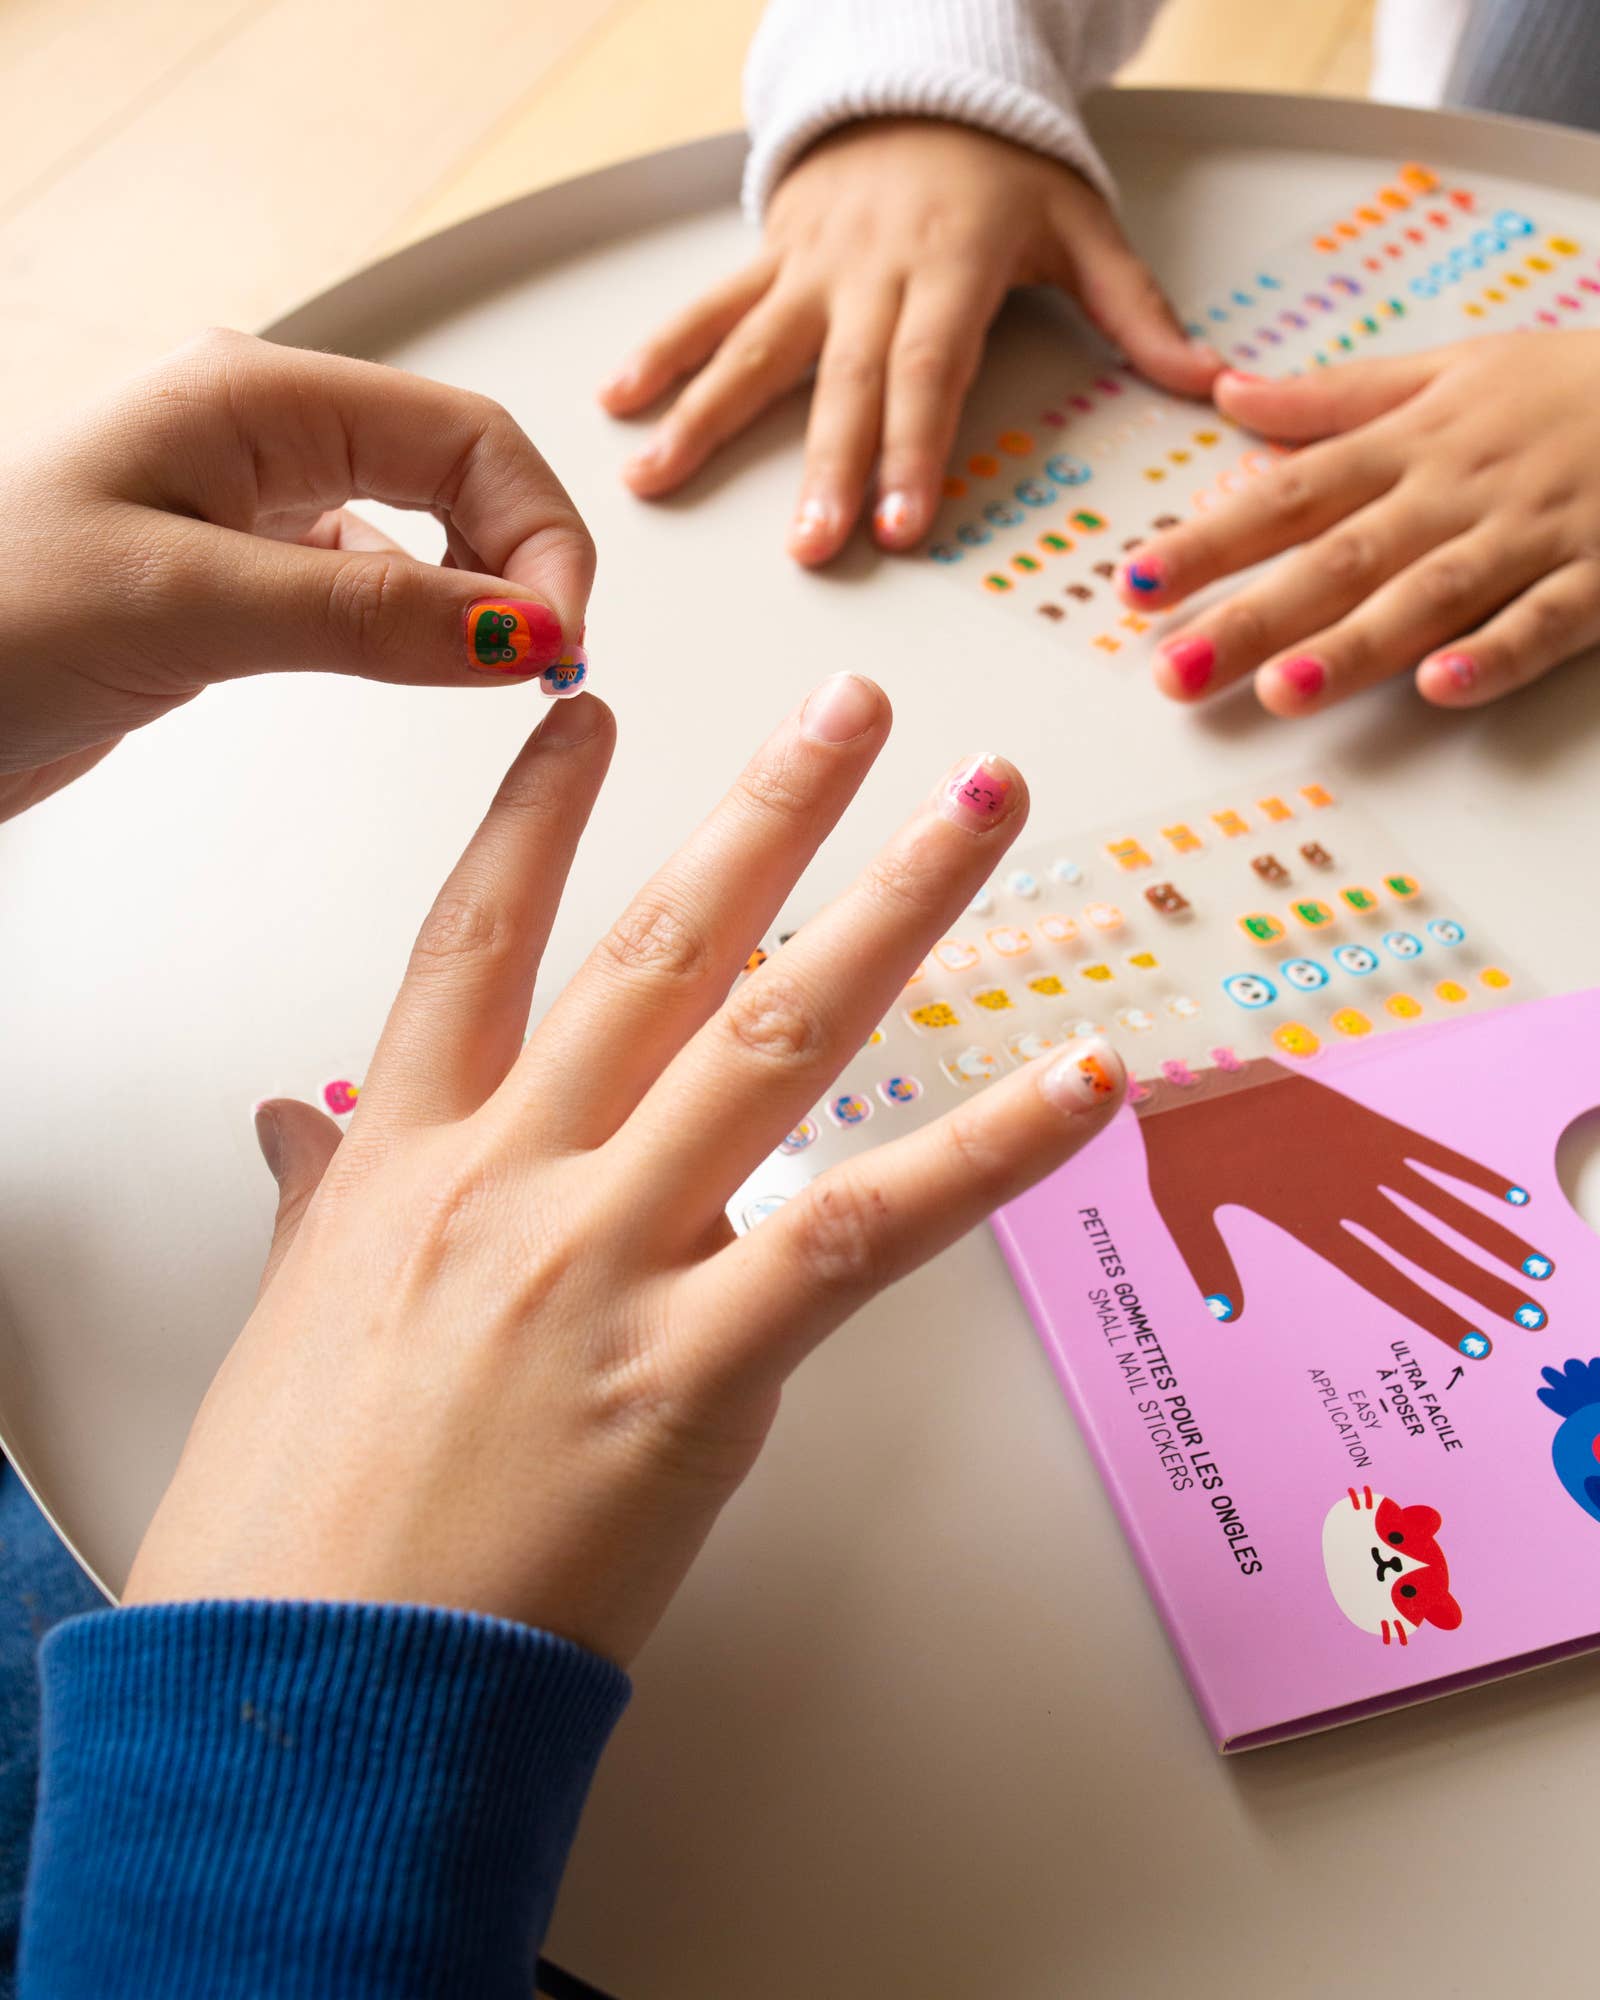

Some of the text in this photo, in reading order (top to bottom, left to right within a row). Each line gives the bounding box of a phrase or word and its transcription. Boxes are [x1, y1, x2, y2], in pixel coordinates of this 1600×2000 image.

[1078, 1207, 1263, 1576] PETITES GOMMETTES POUR LES ONGLES
[1088, 1288, 1194, 1491] SMALL NAIL STICKERS
[1307, 1369, 1373, 1468] APPLICATION
[1347, 1390, 1382, 1430] EASY
[1376, 1368, 1425, 1437] À POSER
[1390, 1340, 1463, 1452] ULTRA FACILE
